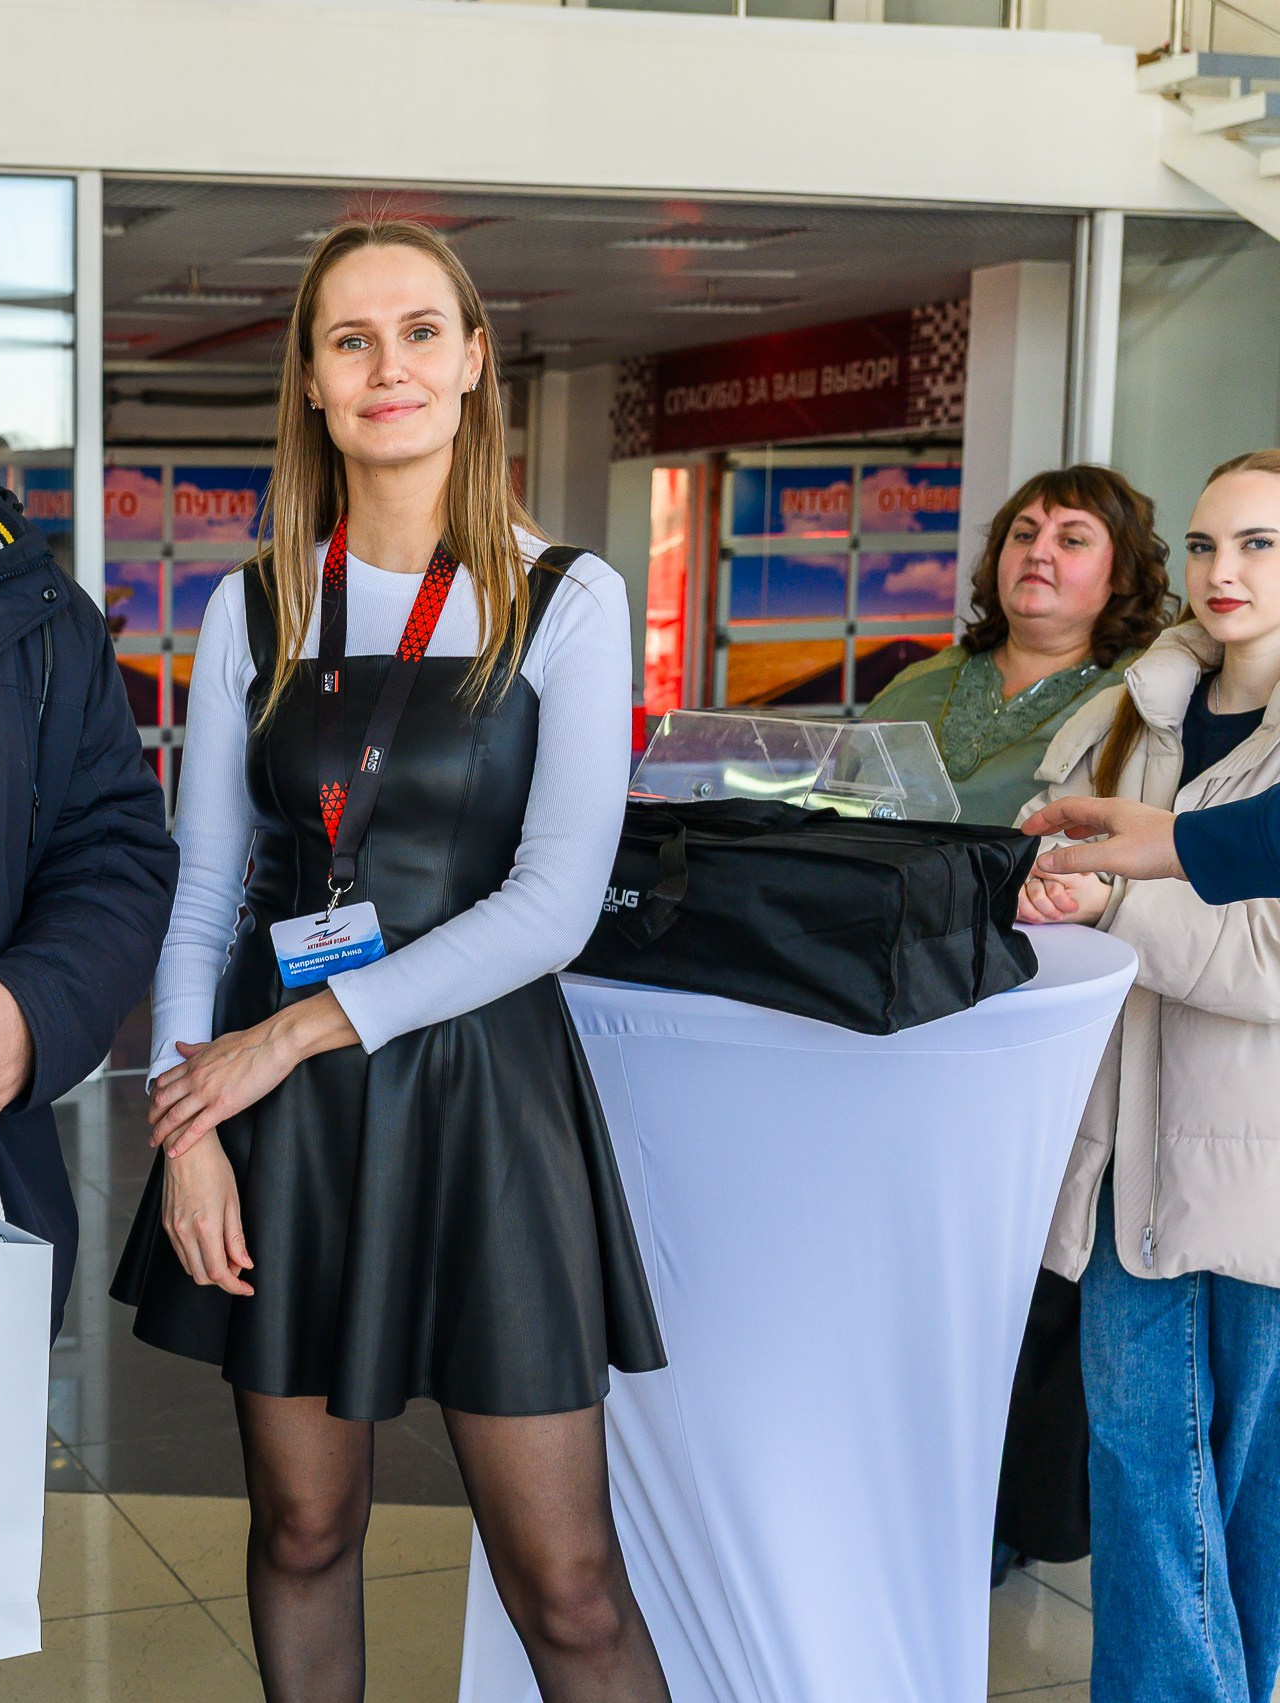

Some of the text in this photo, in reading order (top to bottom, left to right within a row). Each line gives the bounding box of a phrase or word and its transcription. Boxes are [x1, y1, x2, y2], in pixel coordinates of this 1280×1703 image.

[664, 355, 898, 416] СПАСИБО ЗА ВАШ ВЫБОР!
[324, 673, 334, 692] AVS
[367, 748, 381, 772] AVS
[288, 947, 362, 970] Киприянова Анна
